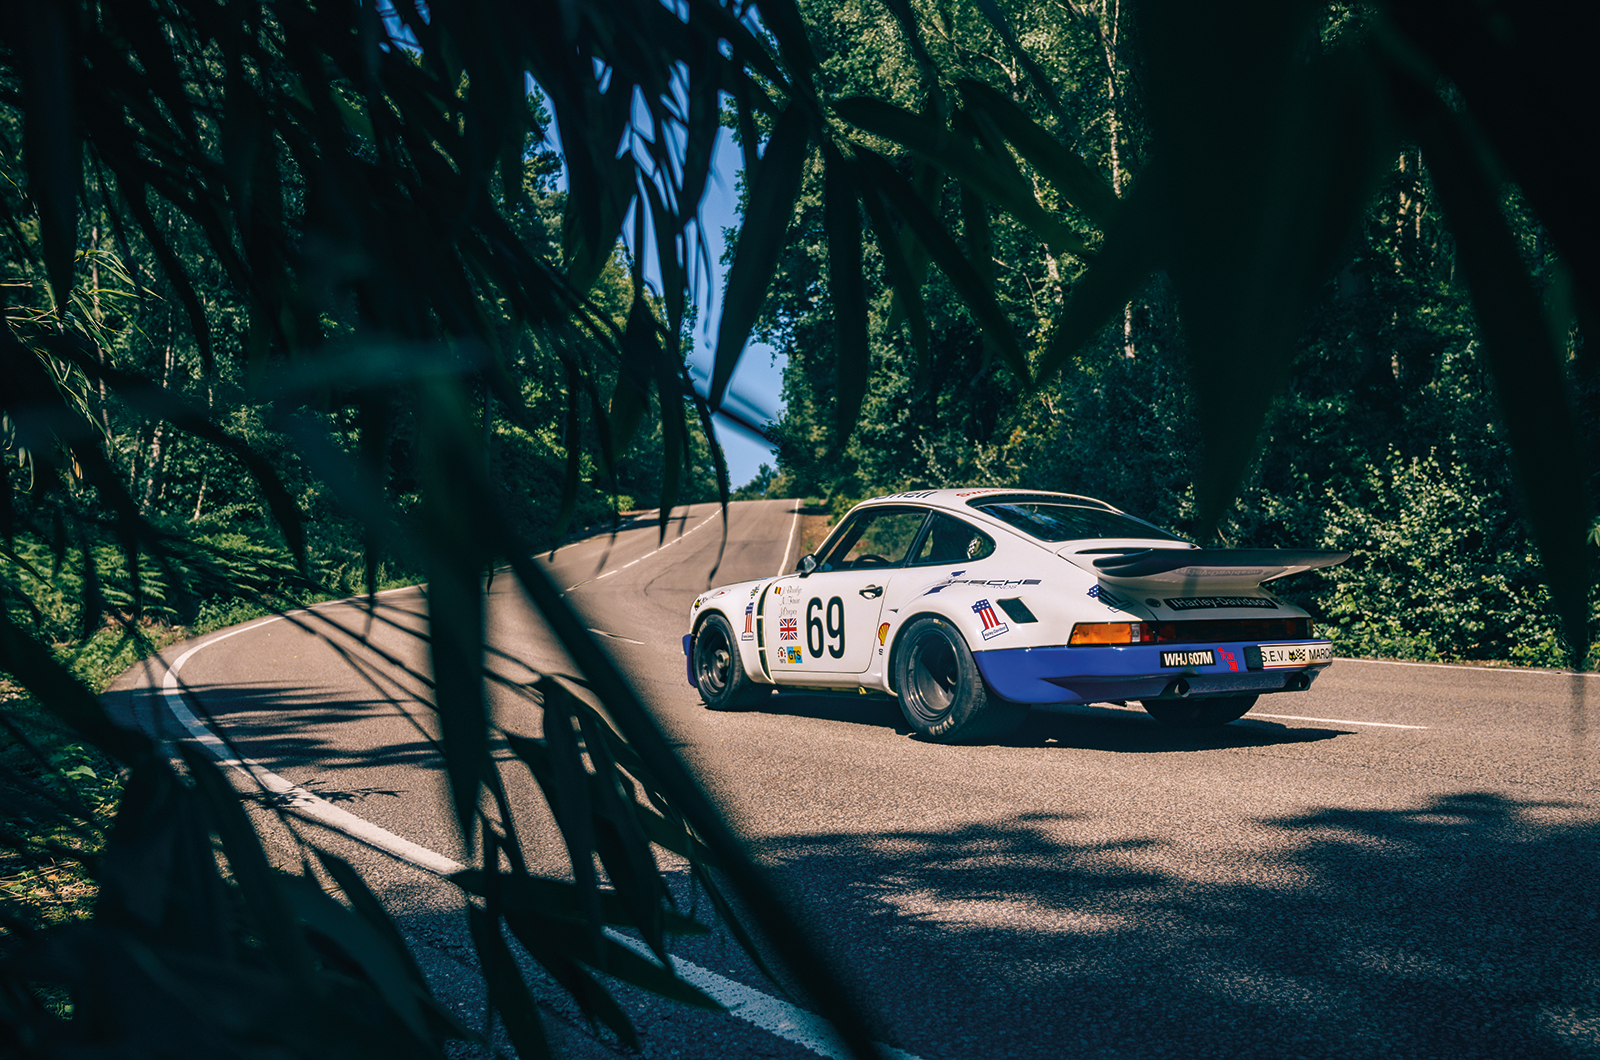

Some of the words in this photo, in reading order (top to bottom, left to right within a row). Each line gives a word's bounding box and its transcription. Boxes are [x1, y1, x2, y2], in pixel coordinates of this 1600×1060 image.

[806, 596, 845, 659] 69
[788, 650, 802, 660] GTS
[1164, 652, 1188, 666] WHJ
[1188, 651, 1213, 666] 607M
[1220, 652, 1235, 661] TOW
[1260, 650, 1287, 663] S.E.V.
